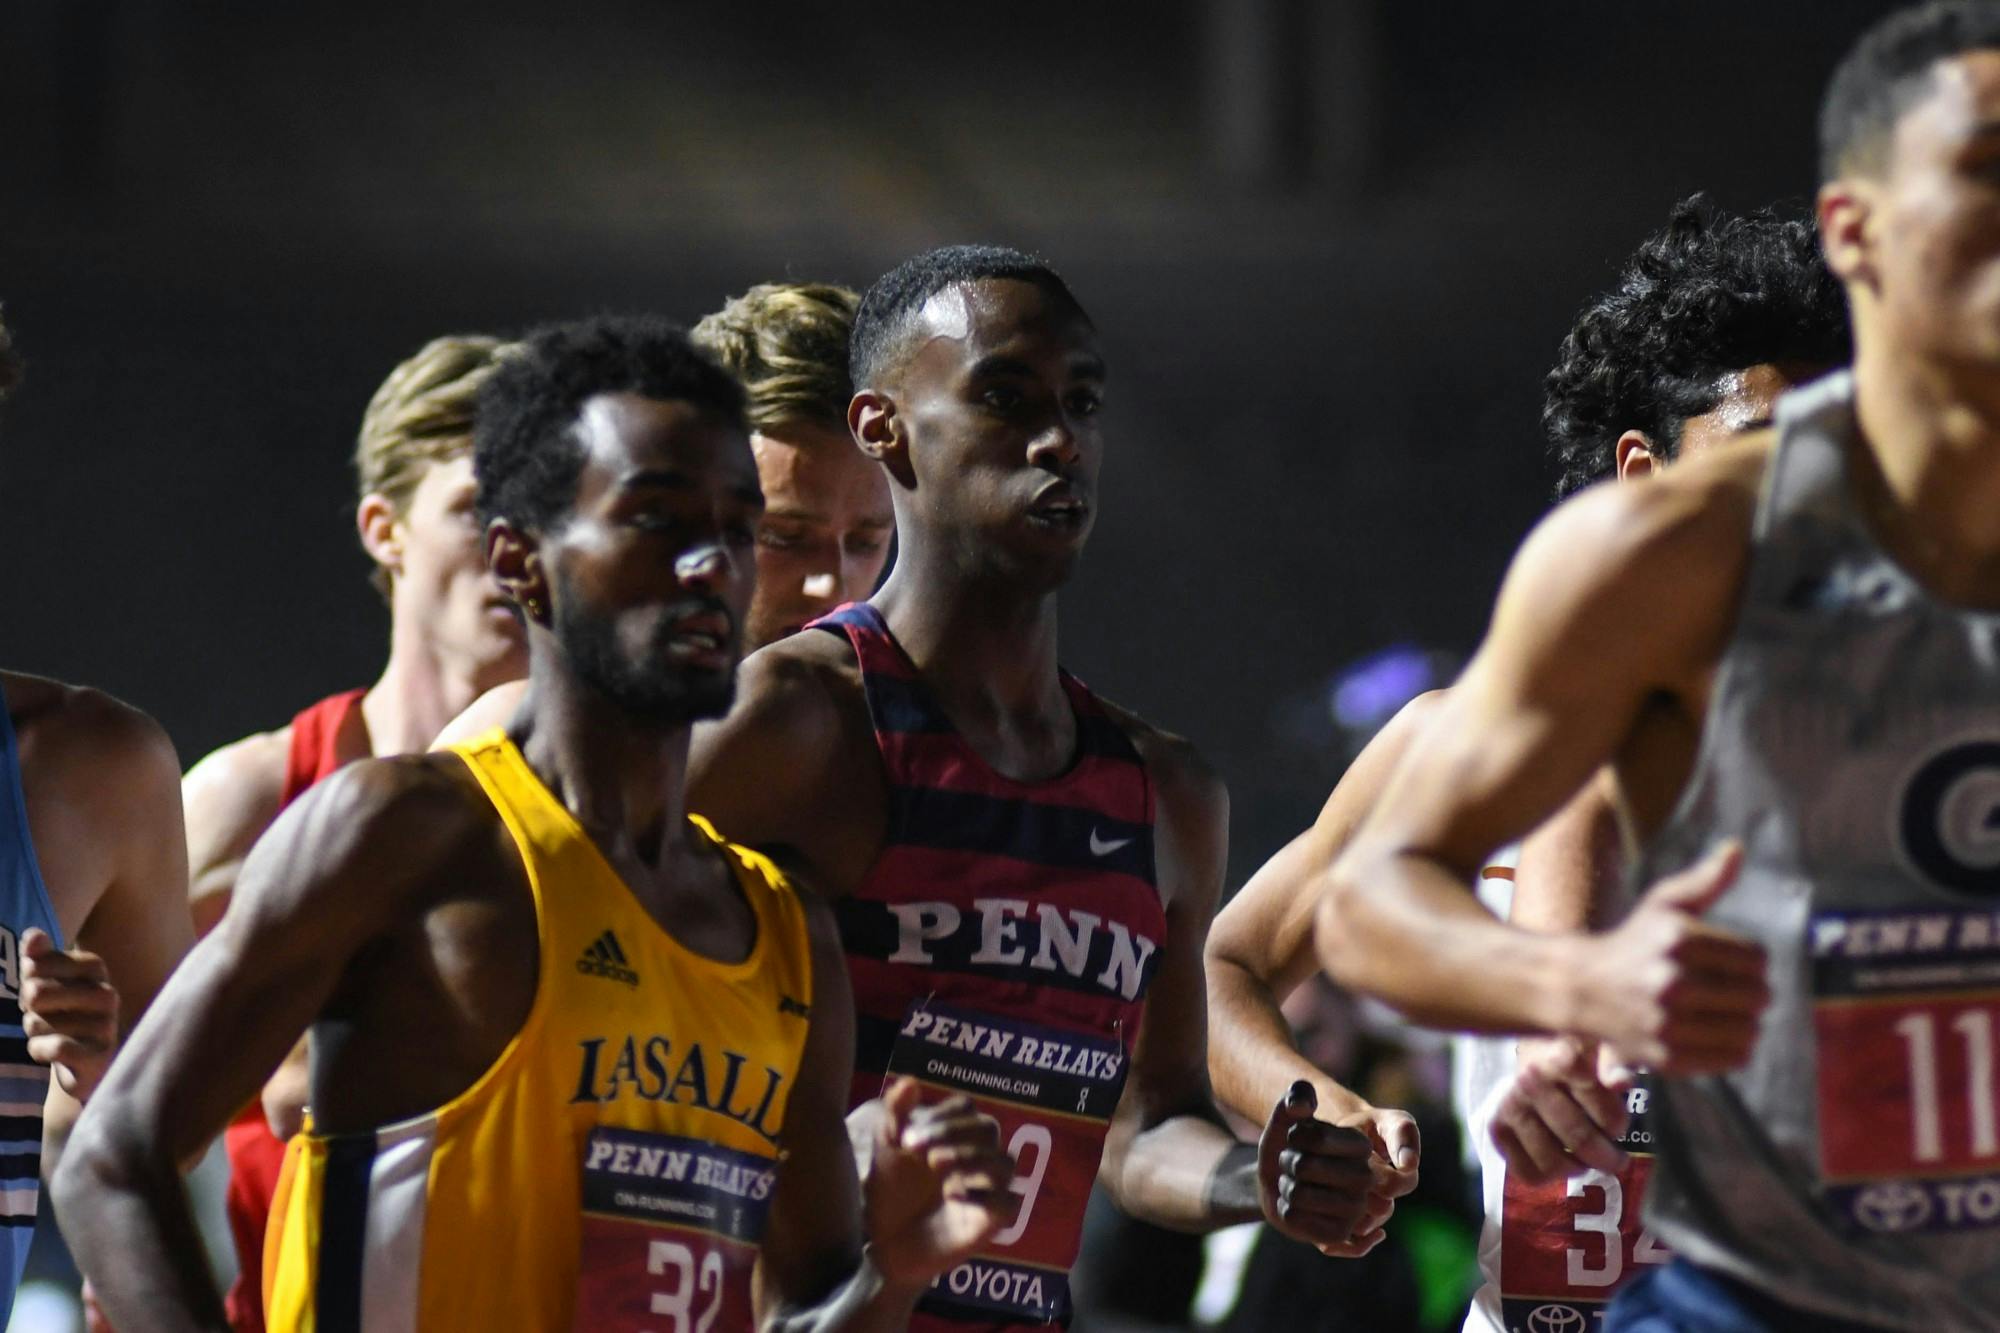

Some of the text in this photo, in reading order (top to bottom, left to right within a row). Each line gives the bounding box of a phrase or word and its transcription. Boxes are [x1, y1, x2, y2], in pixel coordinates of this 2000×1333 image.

[576, 957, 639, 988] adidas
[887, 899, 1157, 1002] PENN
[901, 1010, 1124, 1081] PENN RELAYS
[927, 1058, 1040, 1098] ON-RUNNING.COM
[586, 1140, 692, 1182] PENN
[637, 1241, 724, 1333] 32
[931, 1264, 1043, 1308] OYOTA
